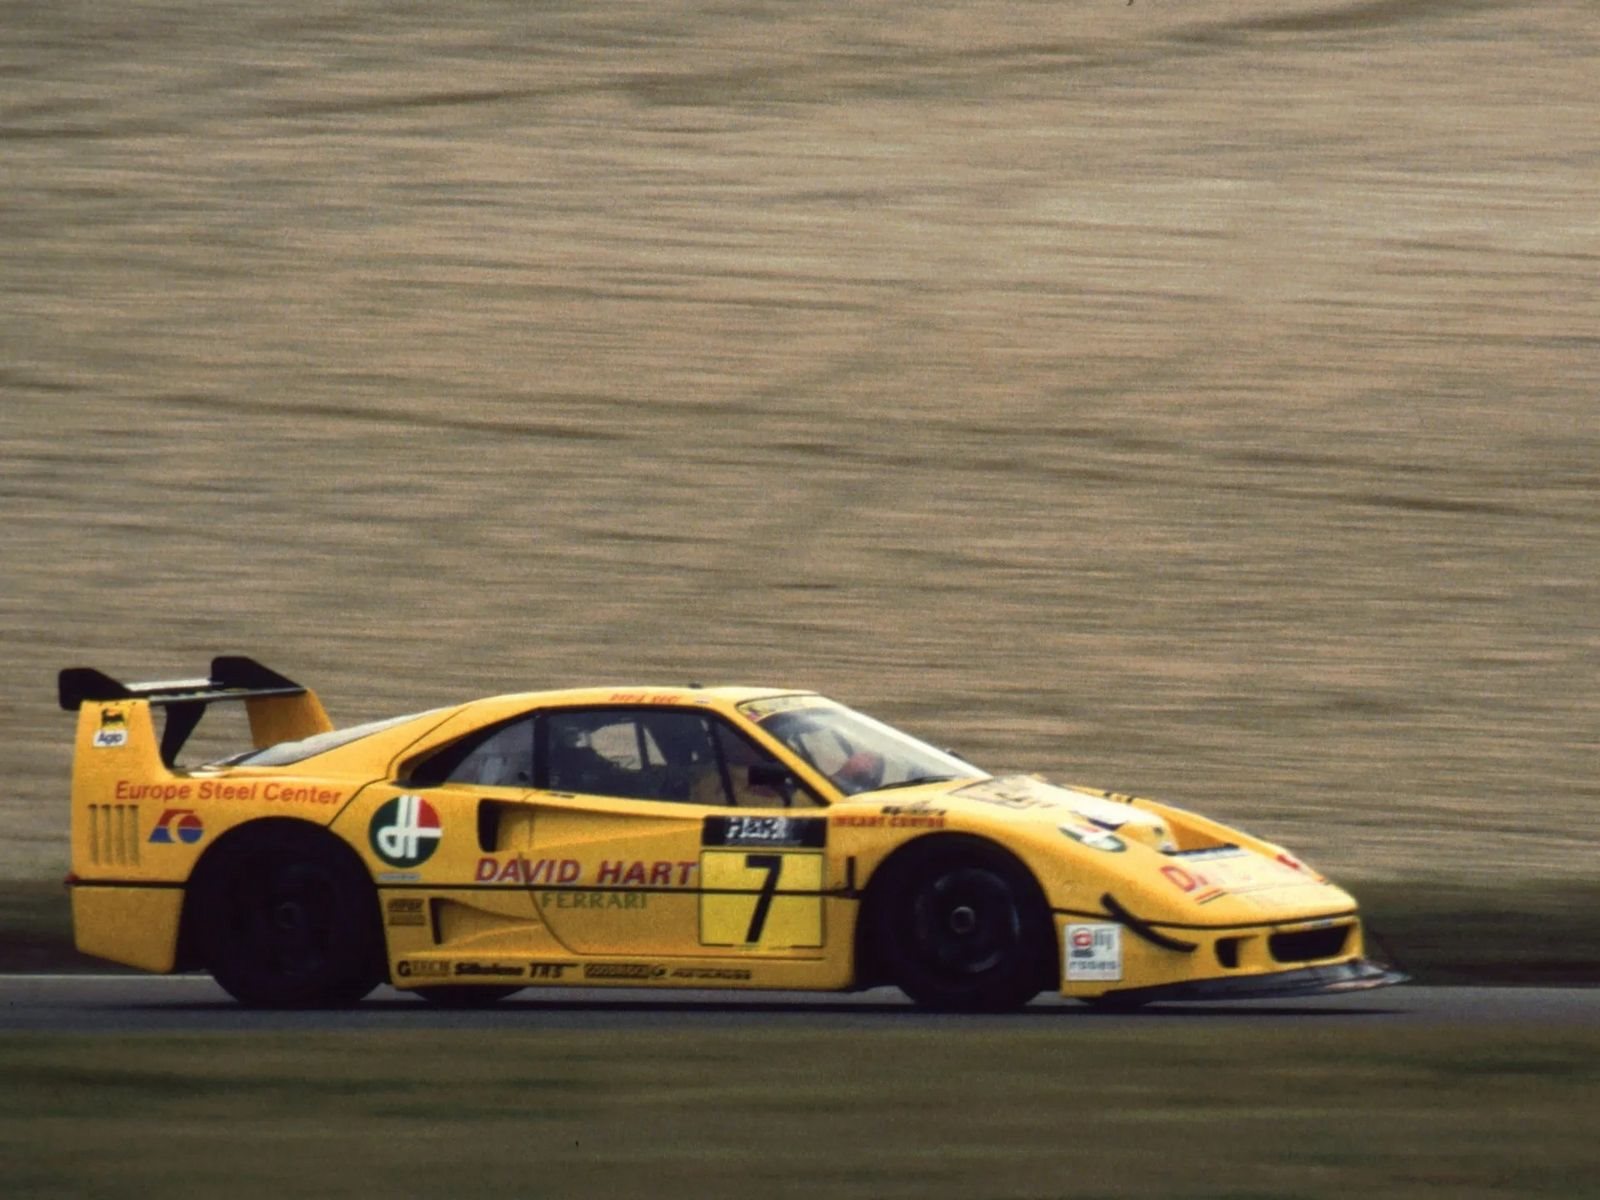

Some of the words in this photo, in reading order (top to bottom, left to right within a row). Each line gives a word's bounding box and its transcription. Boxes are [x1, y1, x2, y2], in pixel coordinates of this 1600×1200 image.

[115, 781, 192, 804] Europe
[197, 781, 257, 800] Steel
[263, 783, 342, 805] Center
[475, 857, 581, 884] DAVID
[596, 860, 699, 885] HART
[541, 891, 647, 909] FERRARI
[745, 855, 783, 943] 7
